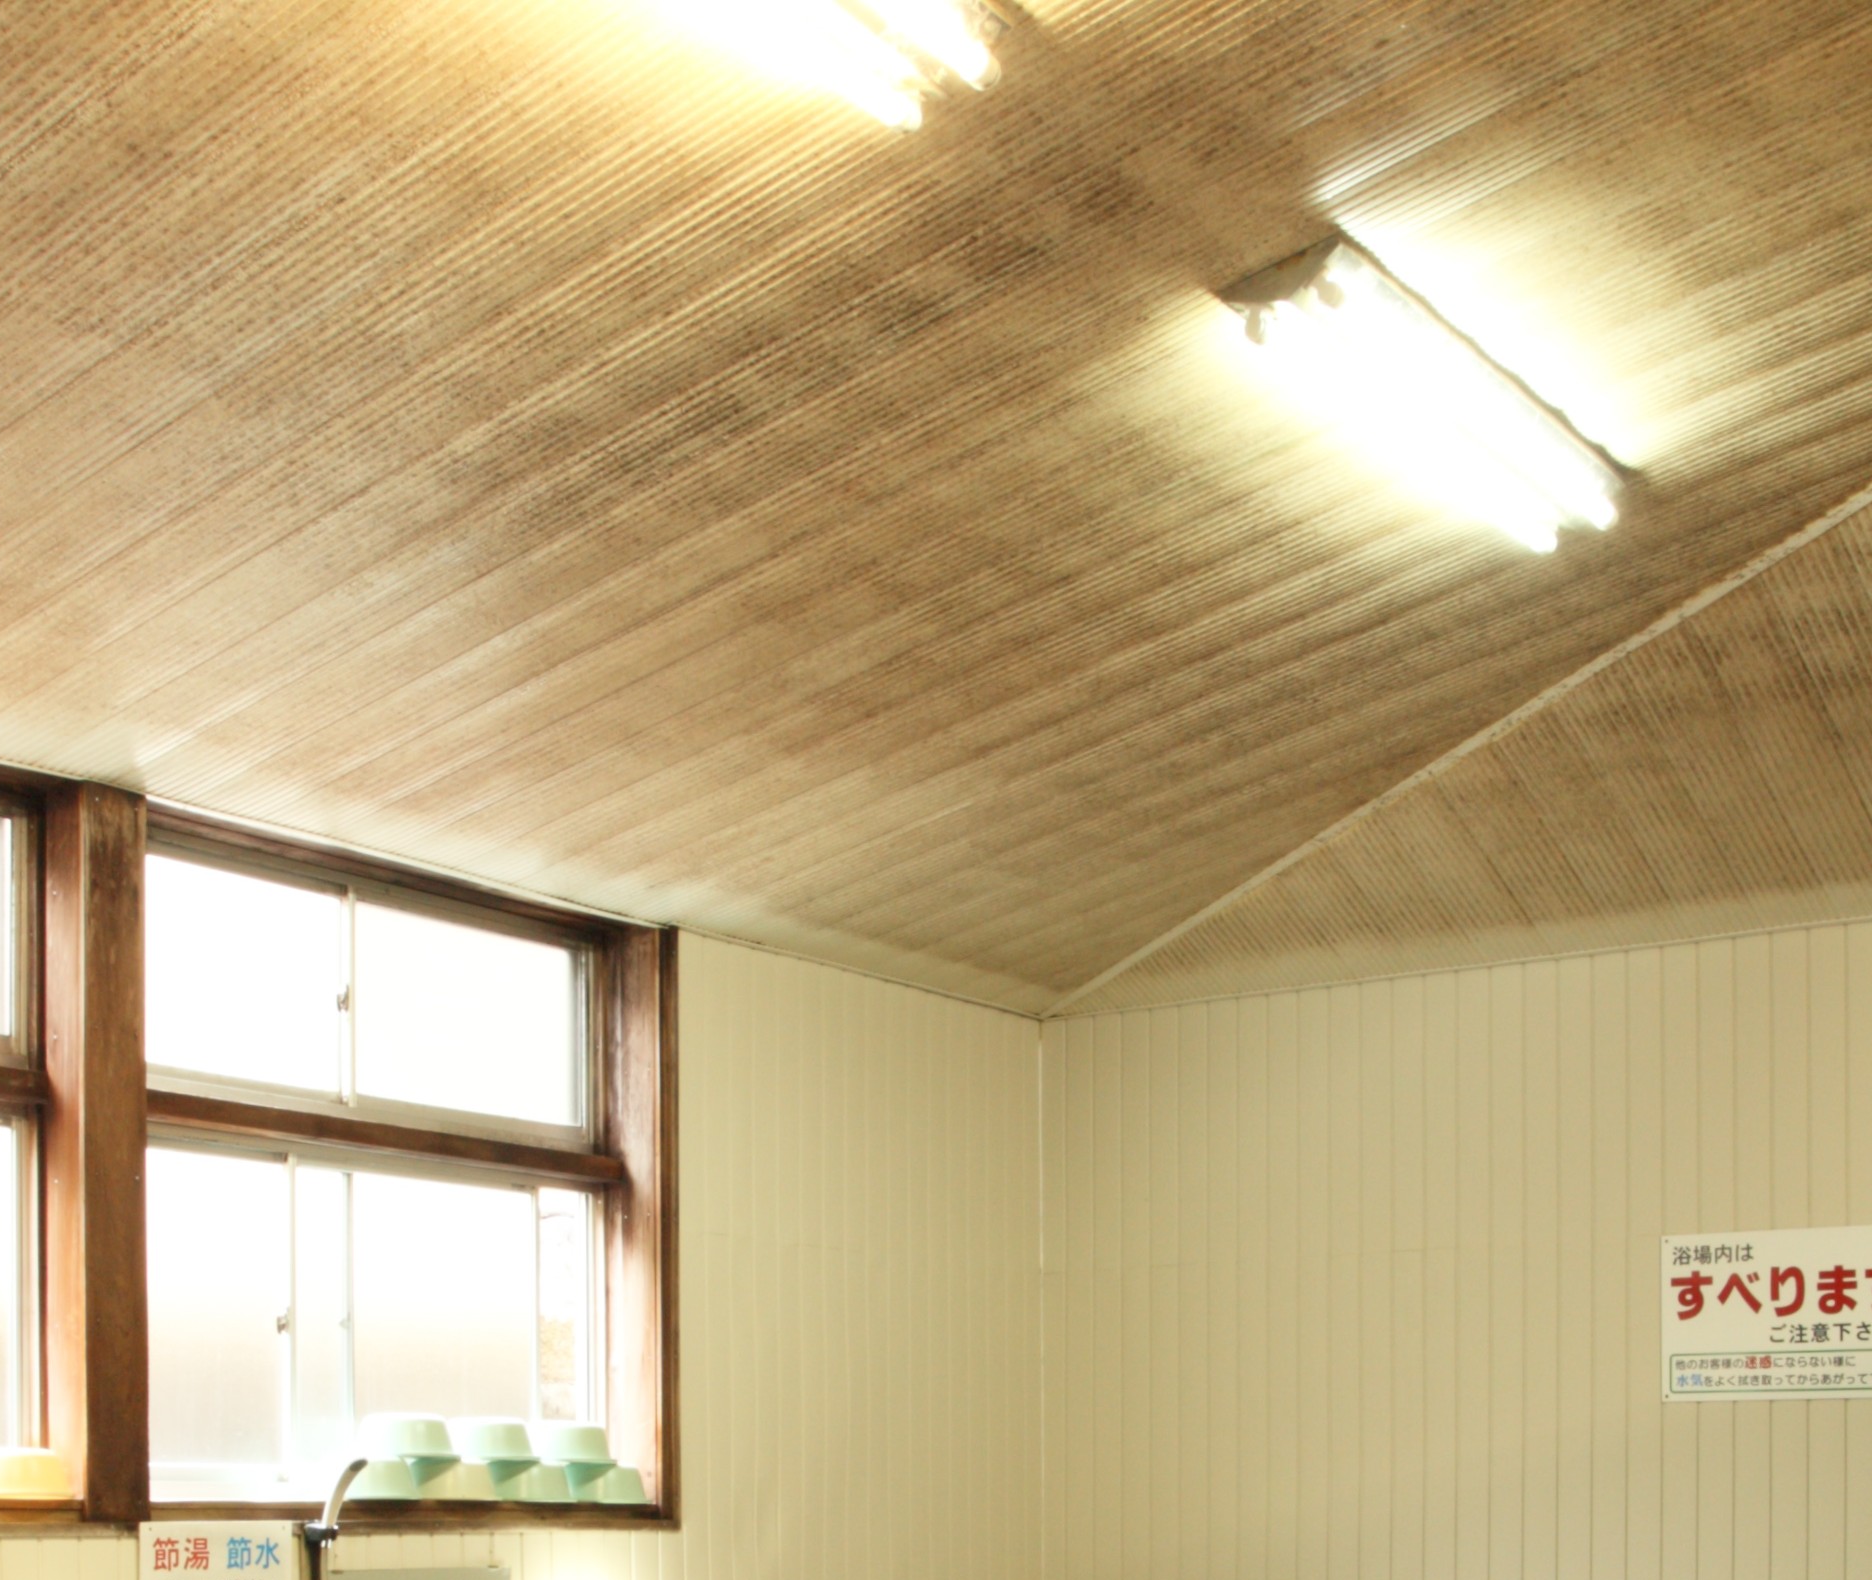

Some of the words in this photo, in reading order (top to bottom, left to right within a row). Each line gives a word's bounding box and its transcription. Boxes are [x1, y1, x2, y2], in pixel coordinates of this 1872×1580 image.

[1672, 1243, 1754, 1266] 浴場内は
[153, 1537, 210, 1571] 節湯
[226, 1537, 280, 1570] 節水
